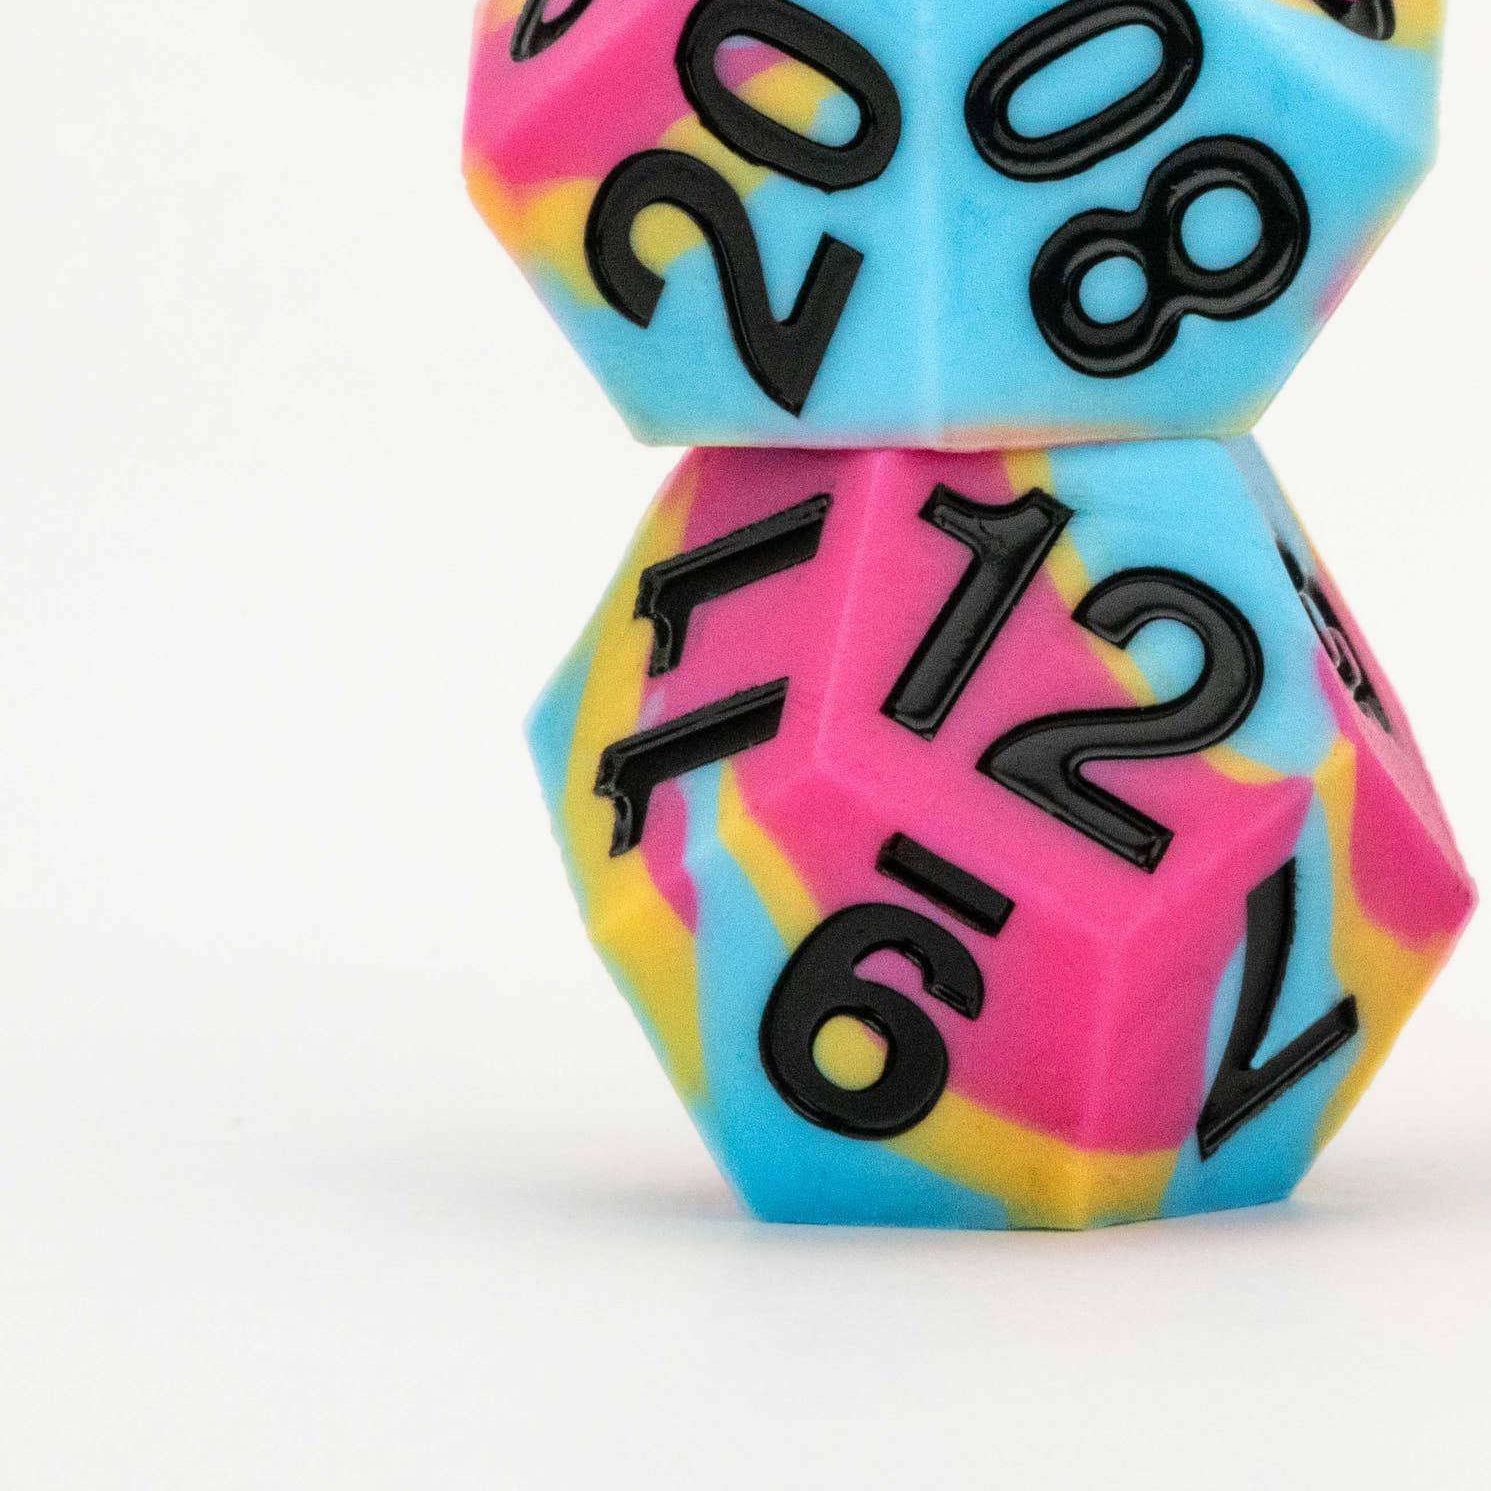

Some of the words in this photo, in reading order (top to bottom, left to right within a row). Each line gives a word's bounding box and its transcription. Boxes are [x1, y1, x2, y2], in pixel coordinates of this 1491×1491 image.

[593, 492, 833, 858] 11
[880, 482, 1265, 874] 12
[1195, 856, 1359, 1163] 7
